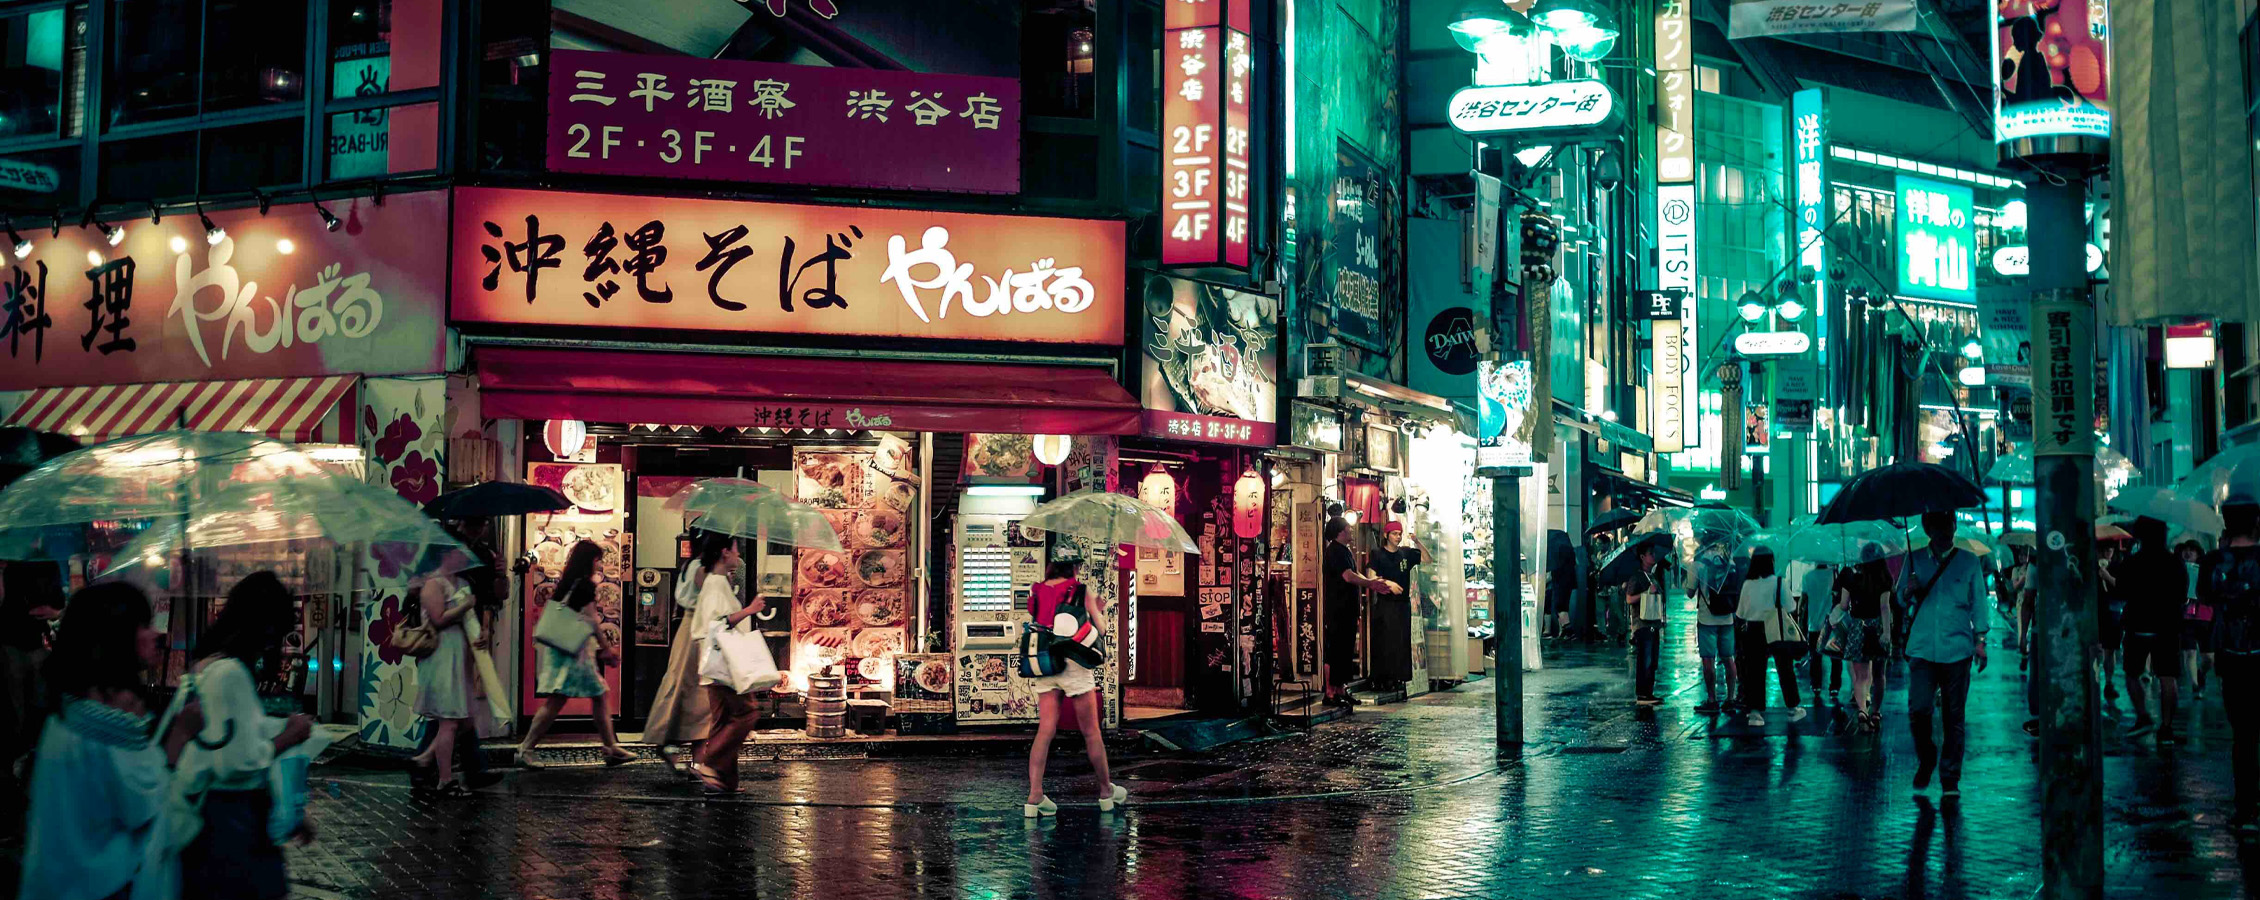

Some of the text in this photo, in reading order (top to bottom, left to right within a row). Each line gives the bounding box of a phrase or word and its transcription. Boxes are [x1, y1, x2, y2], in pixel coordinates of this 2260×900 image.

[1766, 2, 1882, 23] 渋谷センター街
[1179, 29, 1206, 102] 渋谷店
[568, 69, 1002, 130] 三平酒寮 渋谷店
[1455, 93, 1603, 119] 渋谷センター街
[1172, 124, 1212, 154] 2F
[1227, 128, 1247, 156] 2F
[1172, 169, 1210, 198] 3F
[1227, 171, 1247, 200] 3F
[1171, 213, 1210, 242] 4F
[1226, 215, 1247, 244] 4F
[481, 214, 1095, 324] 沖縄そば やんばる
[168, 236, 383, 368] やんばる
[1429, 330, 1475, 350] DAIW
[1665, 334, 1678, 440] BODY FOCUS
[753, 406, 892, 428] 沖縄そば やんばる
[1168, 419, 1202, 437] 渋谷店
[1247, 491, 1258, 530] ホッピー
[1200, 592, 1231, 604] STOP
[1301, 590, 1313, 601] 5F
